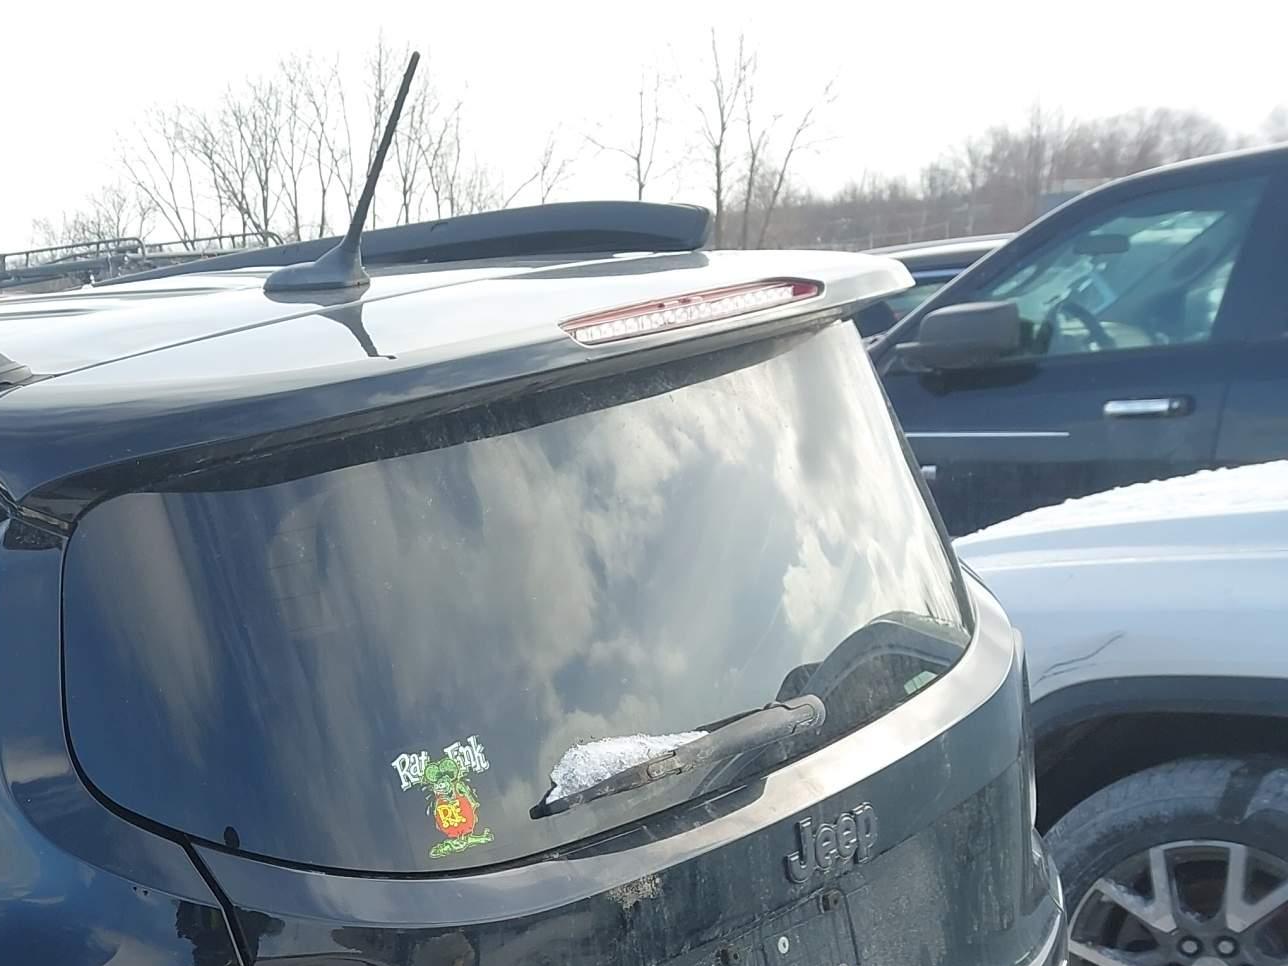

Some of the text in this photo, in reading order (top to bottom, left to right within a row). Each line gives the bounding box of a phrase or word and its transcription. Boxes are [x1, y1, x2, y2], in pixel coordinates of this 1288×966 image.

[391, 734, 490, 792] Rat Fink
[785, 801, 879, 884] Jeep
